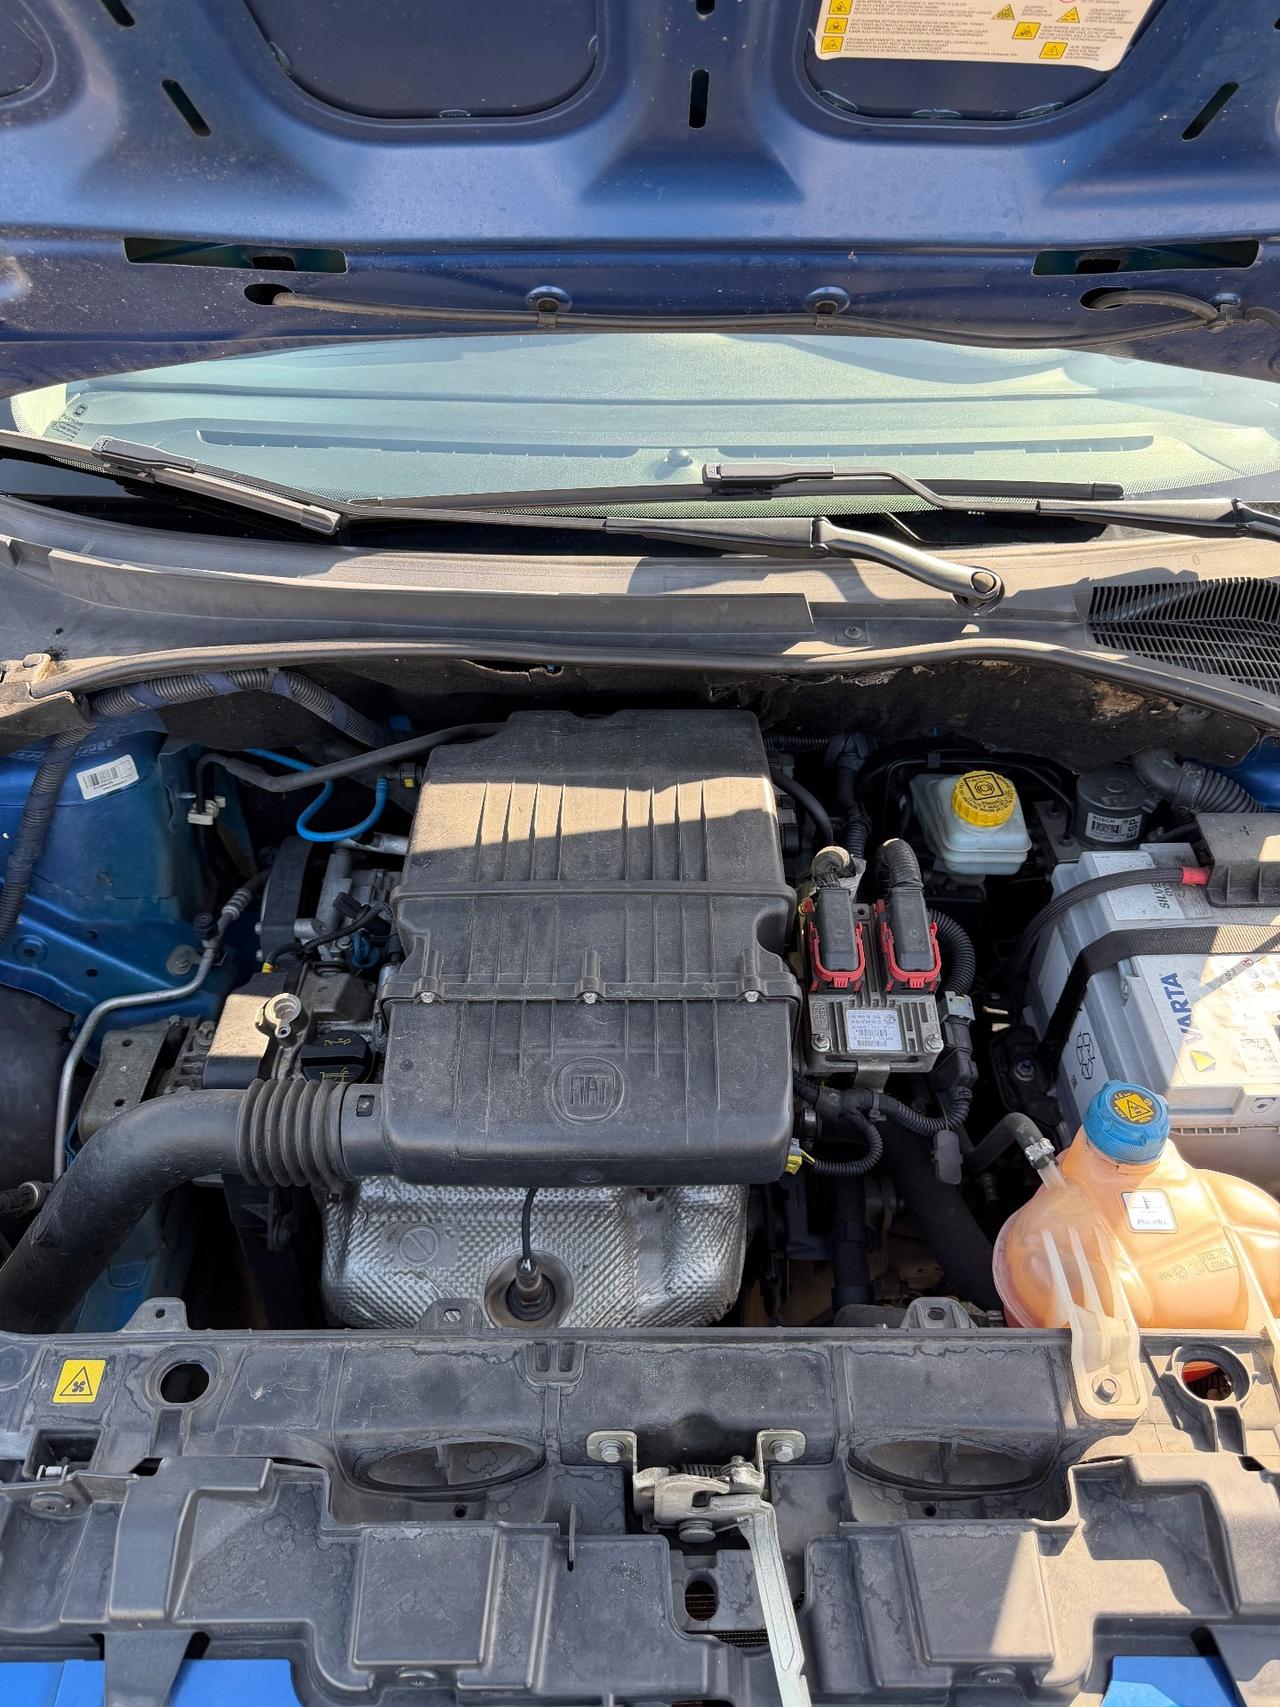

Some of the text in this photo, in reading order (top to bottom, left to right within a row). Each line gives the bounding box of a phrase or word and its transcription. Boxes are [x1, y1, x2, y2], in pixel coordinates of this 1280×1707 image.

[1093, 815, 1115, 824] BOSCH
[1127, 819, 1138, 838] ESP
[1160, 972, 1203, 1046] VARTA
[568, 1075, 611, 1106] FIAT
